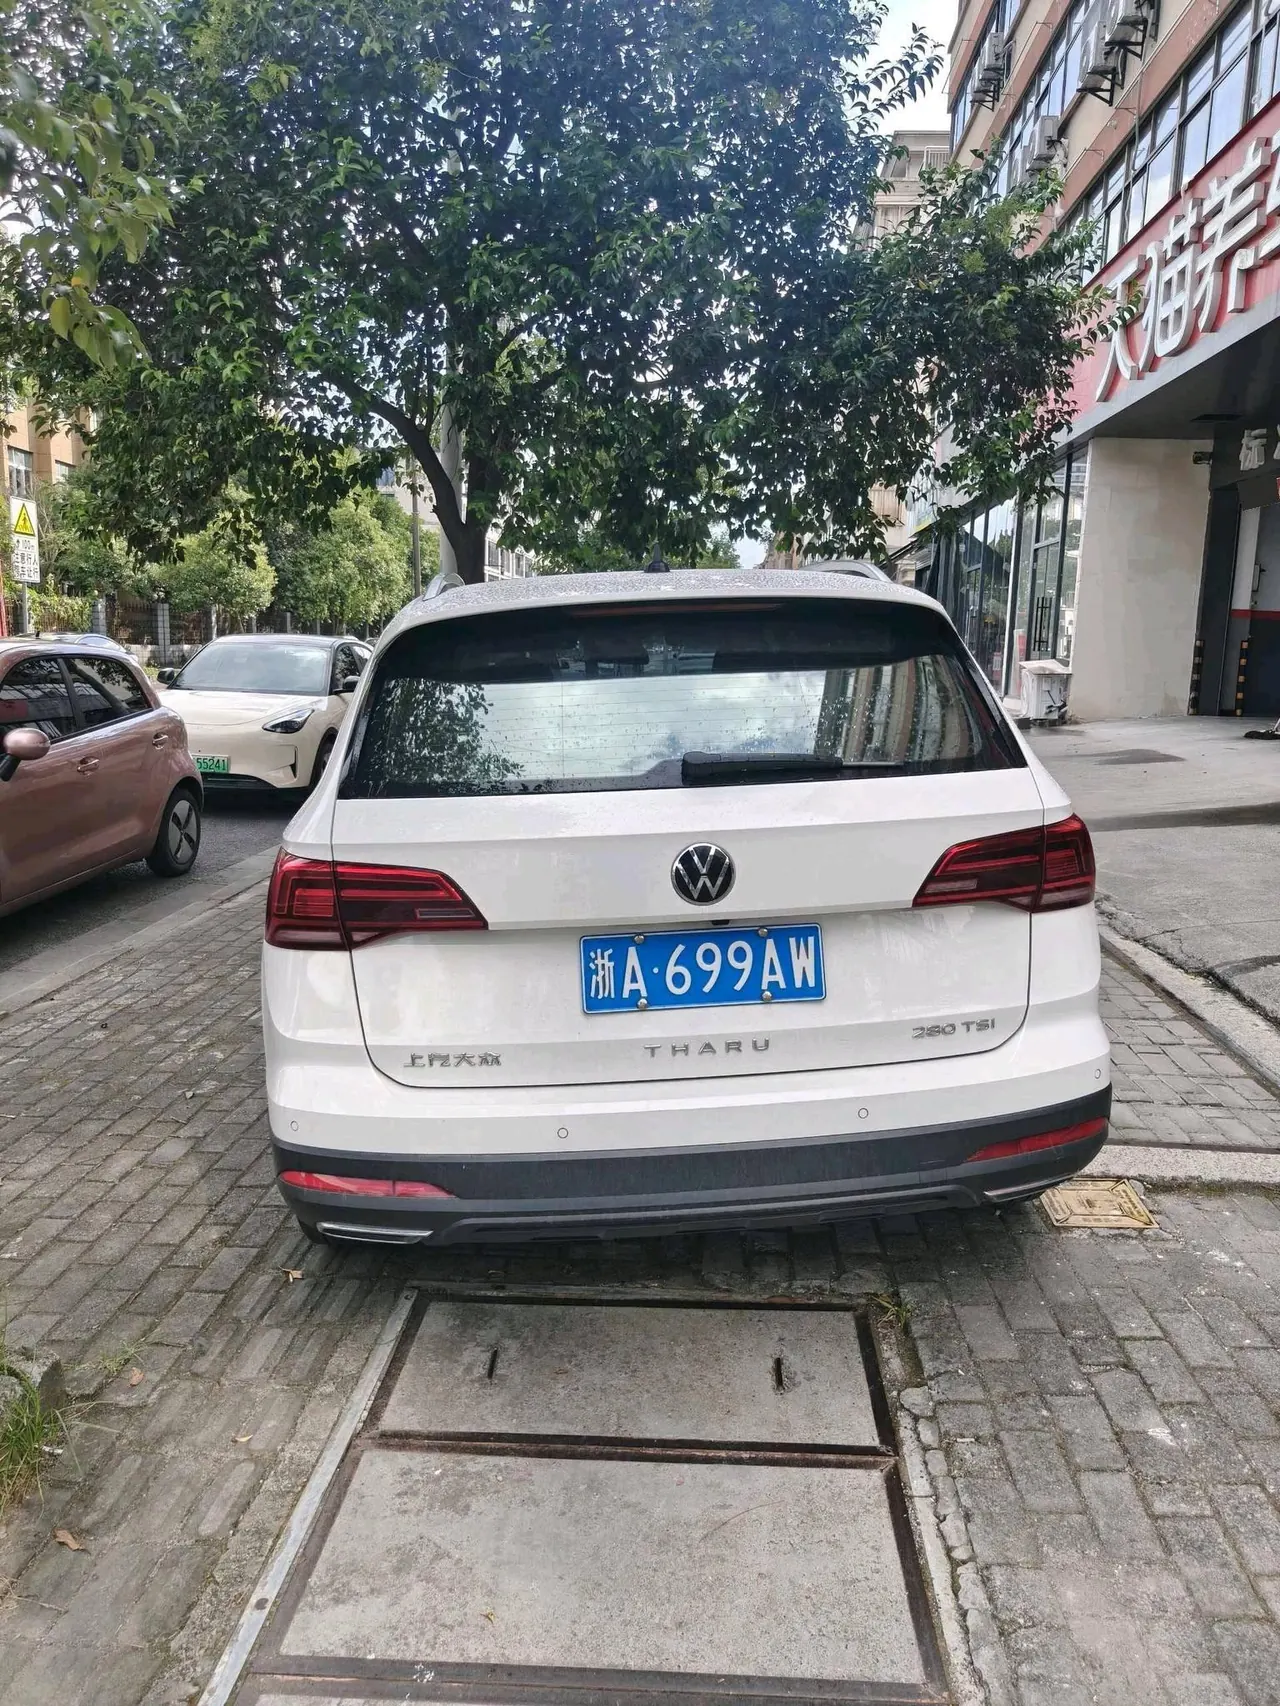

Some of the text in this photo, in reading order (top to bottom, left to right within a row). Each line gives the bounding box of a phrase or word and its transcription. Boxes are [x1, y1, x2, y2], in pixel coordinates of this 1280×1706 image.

[1096, 128, 1280, 402] 天猫养
[196, 757, 227, 771] 55241
[911, 1018, 996, 1039] 280 TSI
[643, 1037, 770, 1058] THARU
[402, 1051, 503, 1068] 上汽大众
